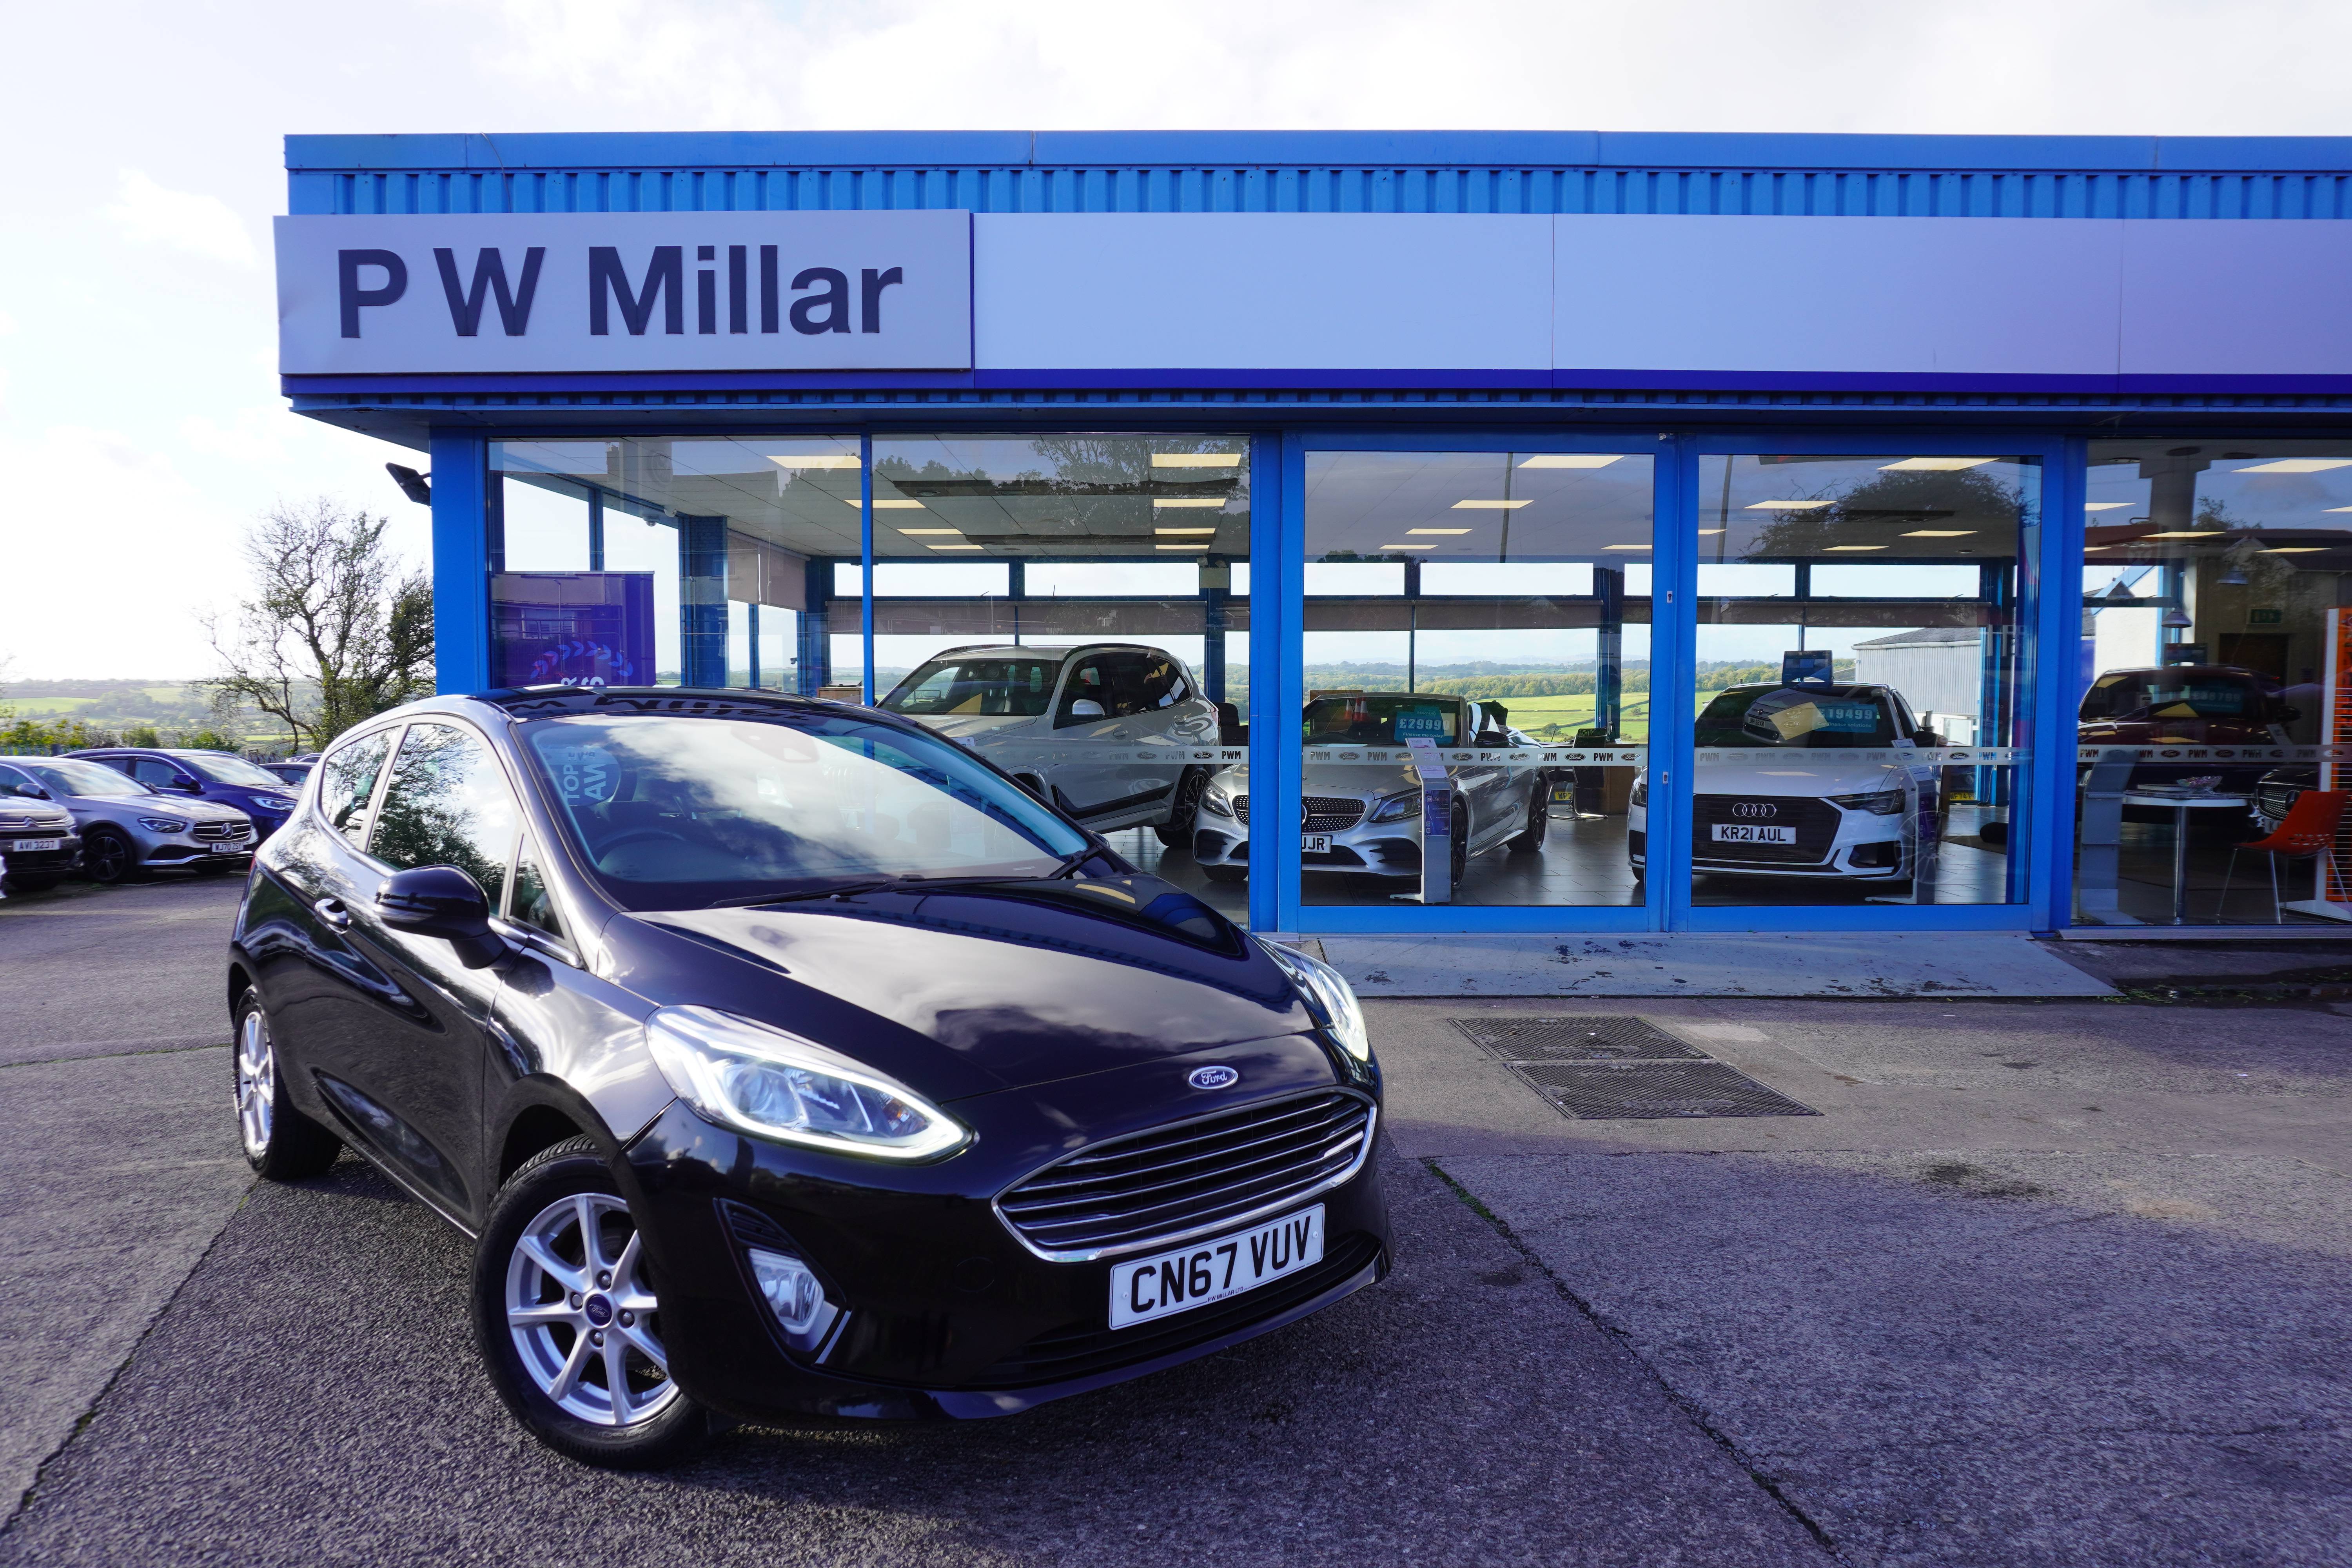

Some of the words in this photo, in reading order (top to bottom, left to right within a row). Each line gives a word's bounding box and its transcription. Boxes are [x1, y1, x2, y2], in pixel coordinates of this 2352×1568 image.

[339, 248, 408, 338] P
[432, 247, 546, 337] W
[589, 245, 903, 336] Millar
[1816, 708, 1873, 720] £19499
[1399, 718, 1450, 731] £29990
[1165, 751, 1185, 760] PWM
[1221, 751, 1241, 760] PWM
[1310, 751, 1330, 760] PWM
[1367, 752, 1387, 761] PWM
[1481, 752, 1501, 762] PWM
[1537, 752, 1557, 762] PWM
[1593, 753, 1613, 762] PWM
[1700, 753, 1719, 762] PWM
[1866, 752, 1886, 761] PWM
[2080, 749, 2099, 757] PWM
[2188, 749, 2208, 758] PWM
[1721, 826, 1753, 840] KR21
[1758, 828, 1786, 842] AUL
[34, 840, 54, 849] 3237
[1131, 1242, 1238, 1314] CN67
[1250, 1216, 1311, 1279] VUV
